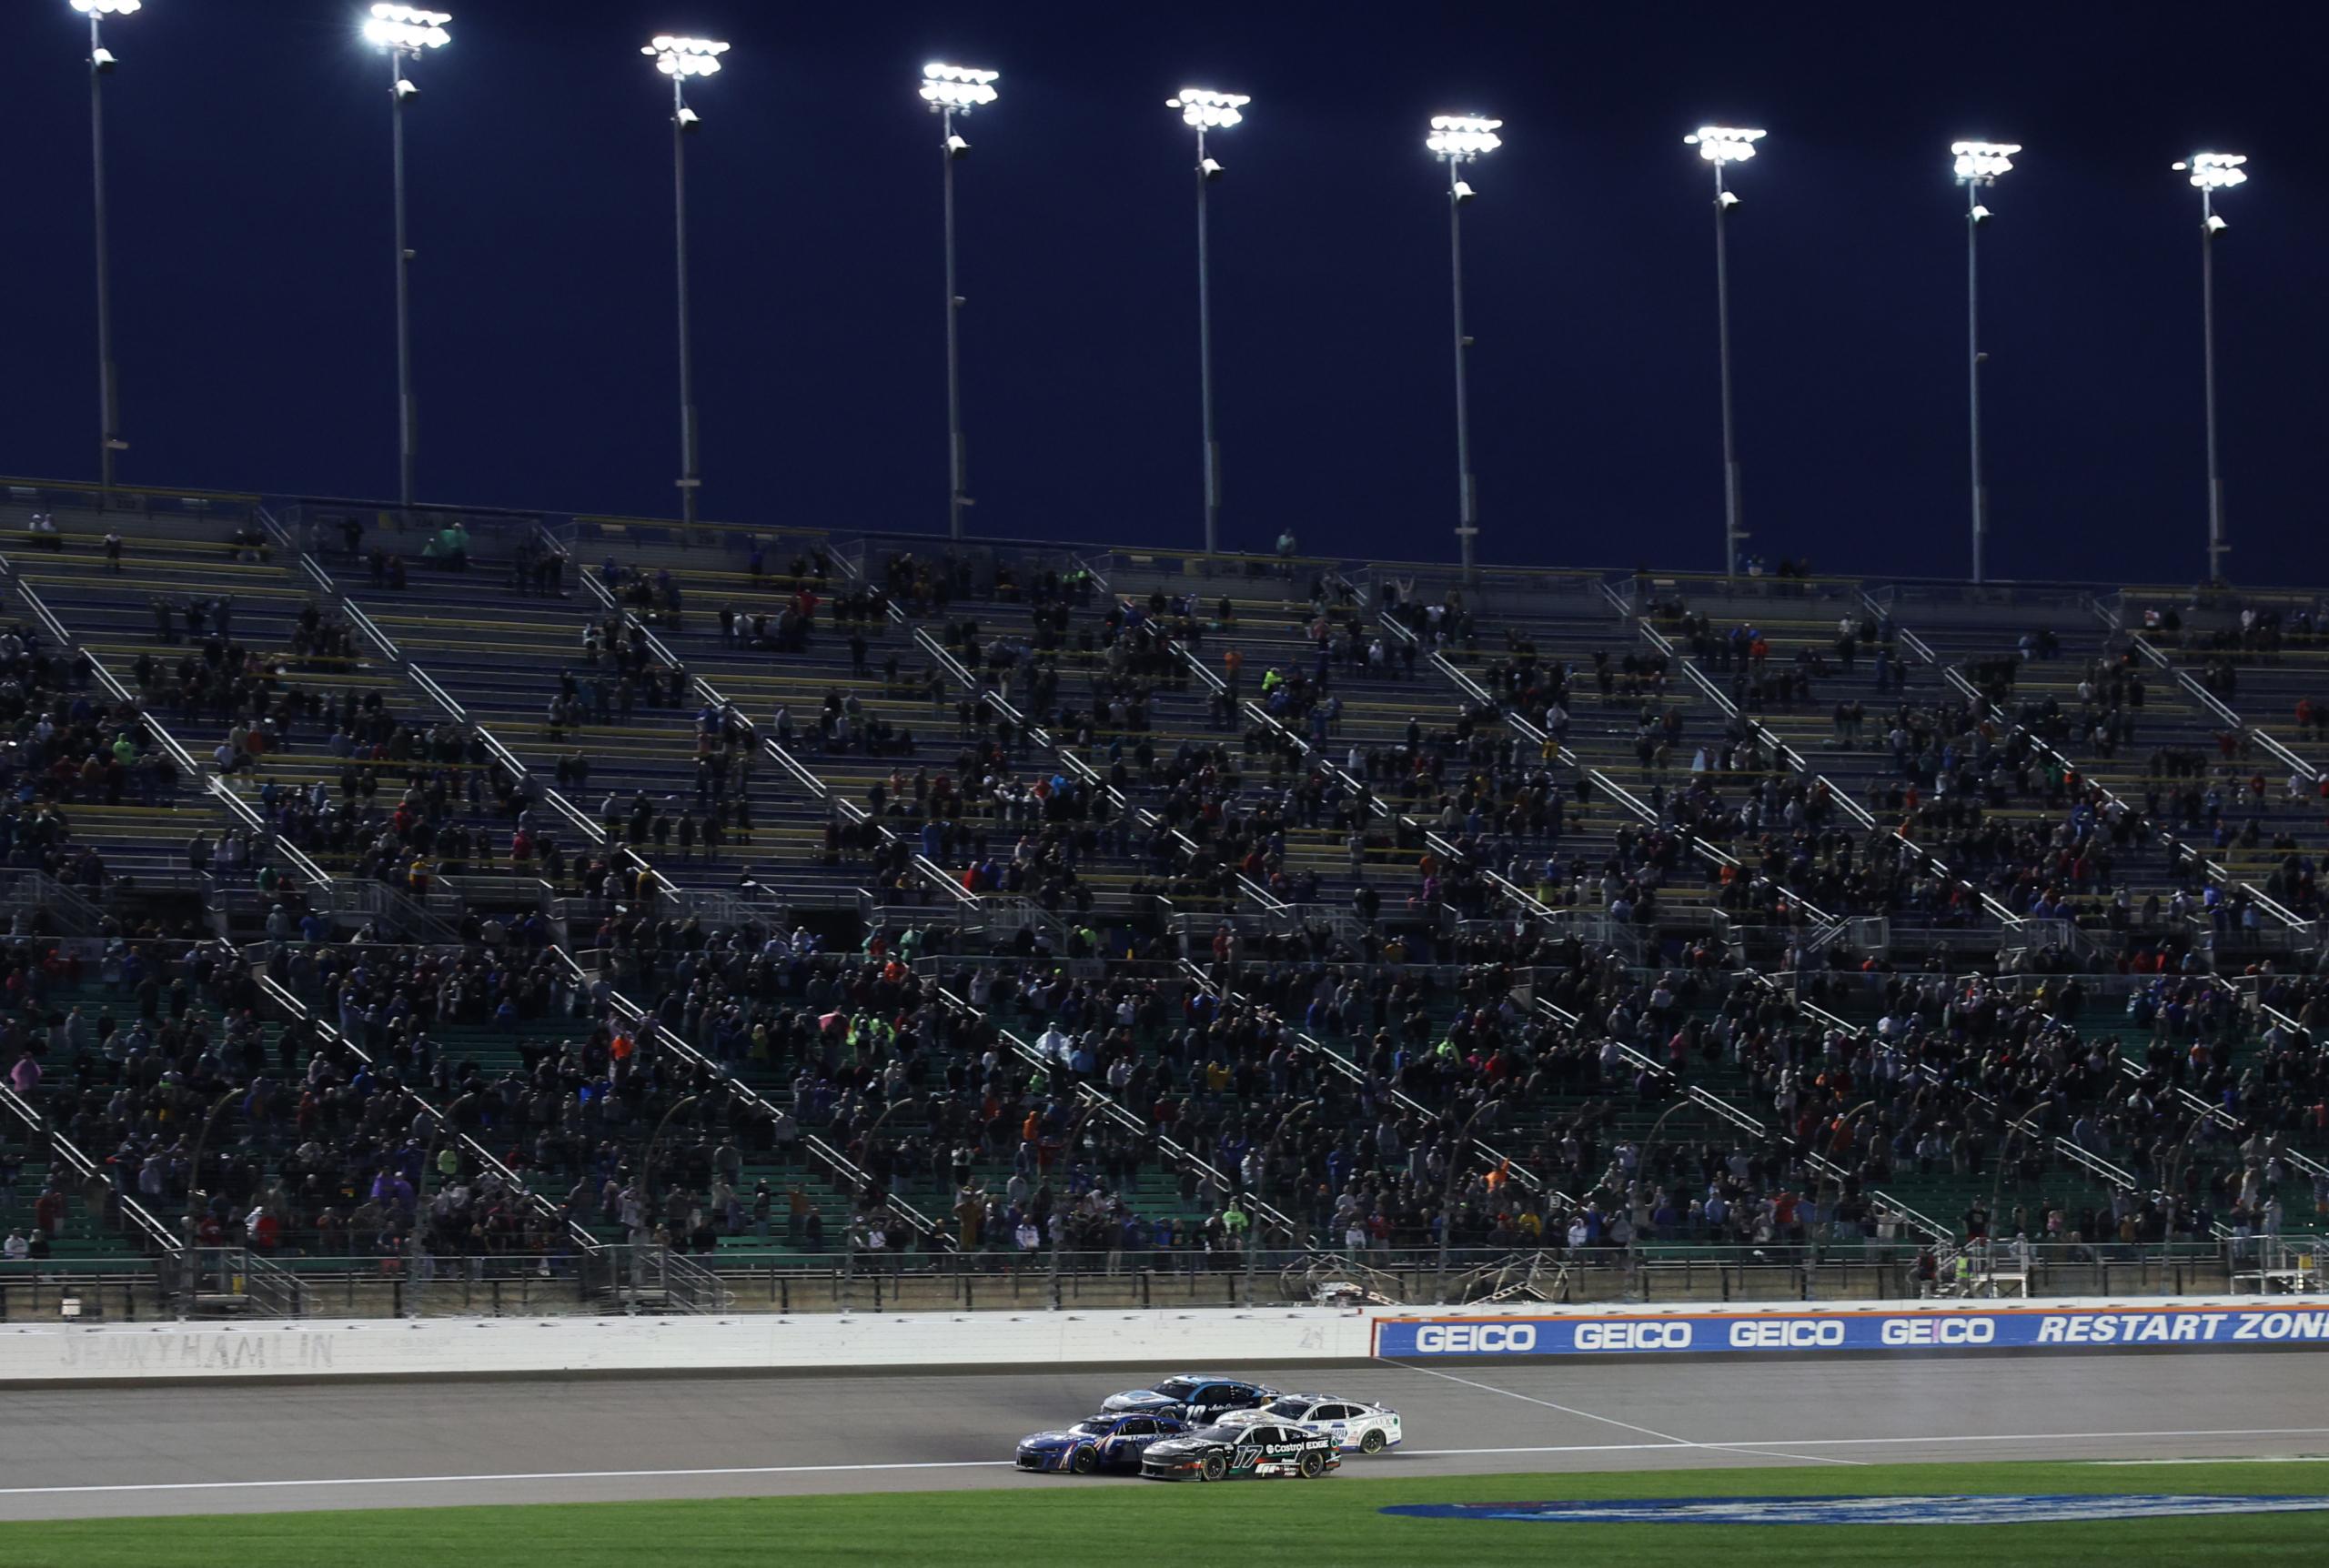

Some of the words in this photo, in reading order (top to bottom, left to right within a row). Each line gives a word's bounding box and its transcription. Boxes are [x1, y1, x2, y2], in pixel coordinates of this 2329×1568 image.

[1416, 1325, 1537, 1352] GEICO
[1574, 1322, 1692, 1349] GEICO
[1729, 1321, 1845, 1346] GEICO
[1881, 1318, 1995, 1344] GEICO
[2038, 1315, 2227, 1342] RESTART
[181, 1334, 334, 1369] HAMLIN
[1232, 1444, 1264, 1469] 17
[1274, 1441, 1305, 1453] Castrol
[1306, 1439, 1329, 1450] EDGE
